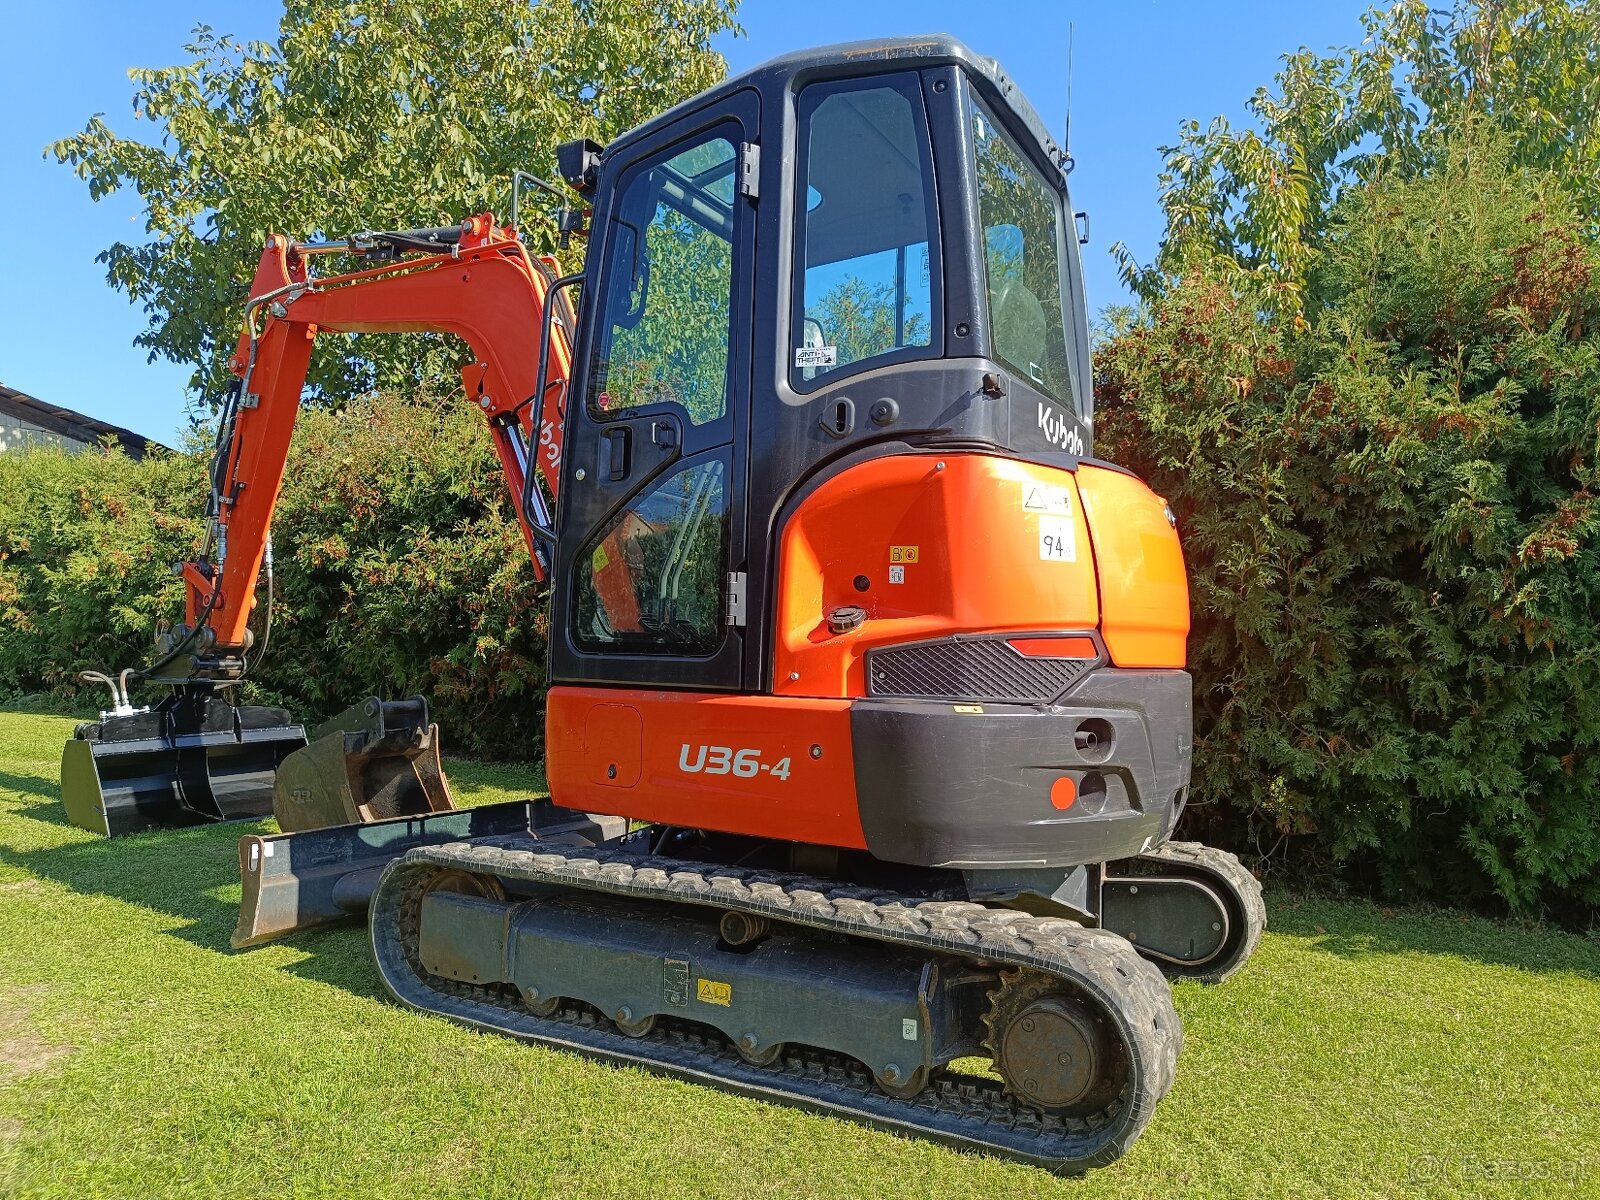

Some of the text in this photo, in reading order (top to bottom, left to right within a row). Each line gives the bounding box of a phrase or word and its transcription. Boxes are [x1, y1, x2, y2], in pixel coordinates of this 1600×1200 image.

[1038, 402, 1083, 457] Kubota
[1043, 535, 1064, 557] 94
[679, 744, 791, 781] U36-4
